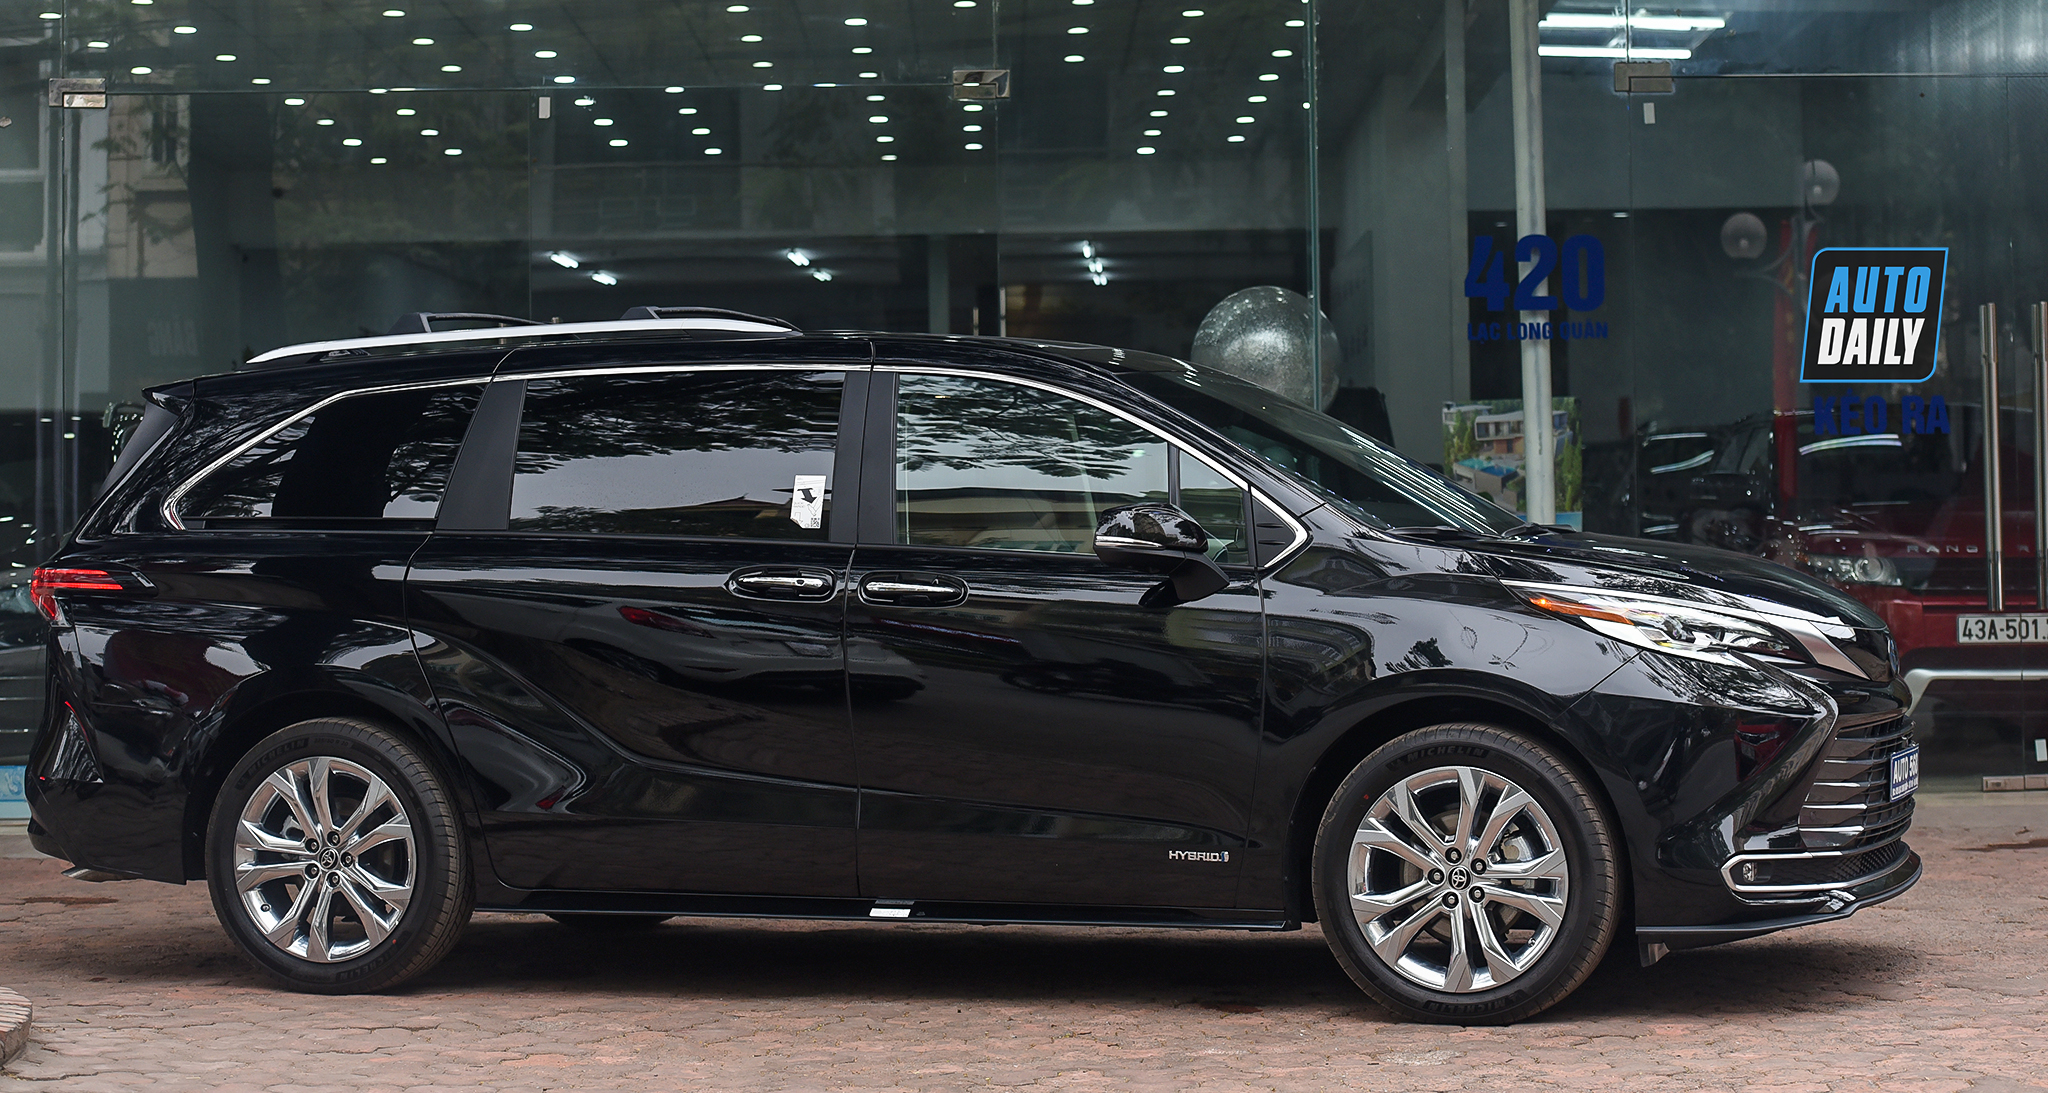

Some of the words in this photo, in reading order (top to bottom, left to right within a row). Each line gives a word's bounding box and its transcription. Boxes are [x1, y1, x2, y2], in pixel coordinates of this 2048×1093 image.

[1464, 234, 1605, 312] 420
[1467, 322, 1501, 344] LẠC
[1508, 322, 1553, 341] LONG
[1813, 388, 1888, 435] KÉO
[1901, 395, 1951, 434] RA
[1907, 544, 1982, 554] RANG
[1962, 619, 2048, 640] 43A-501.
[1407, 745, 1485, 762] MICHELIN
[1892, 755, 1909, 784] AUTO
[1169, 850, 1219, 861] HYBRID
